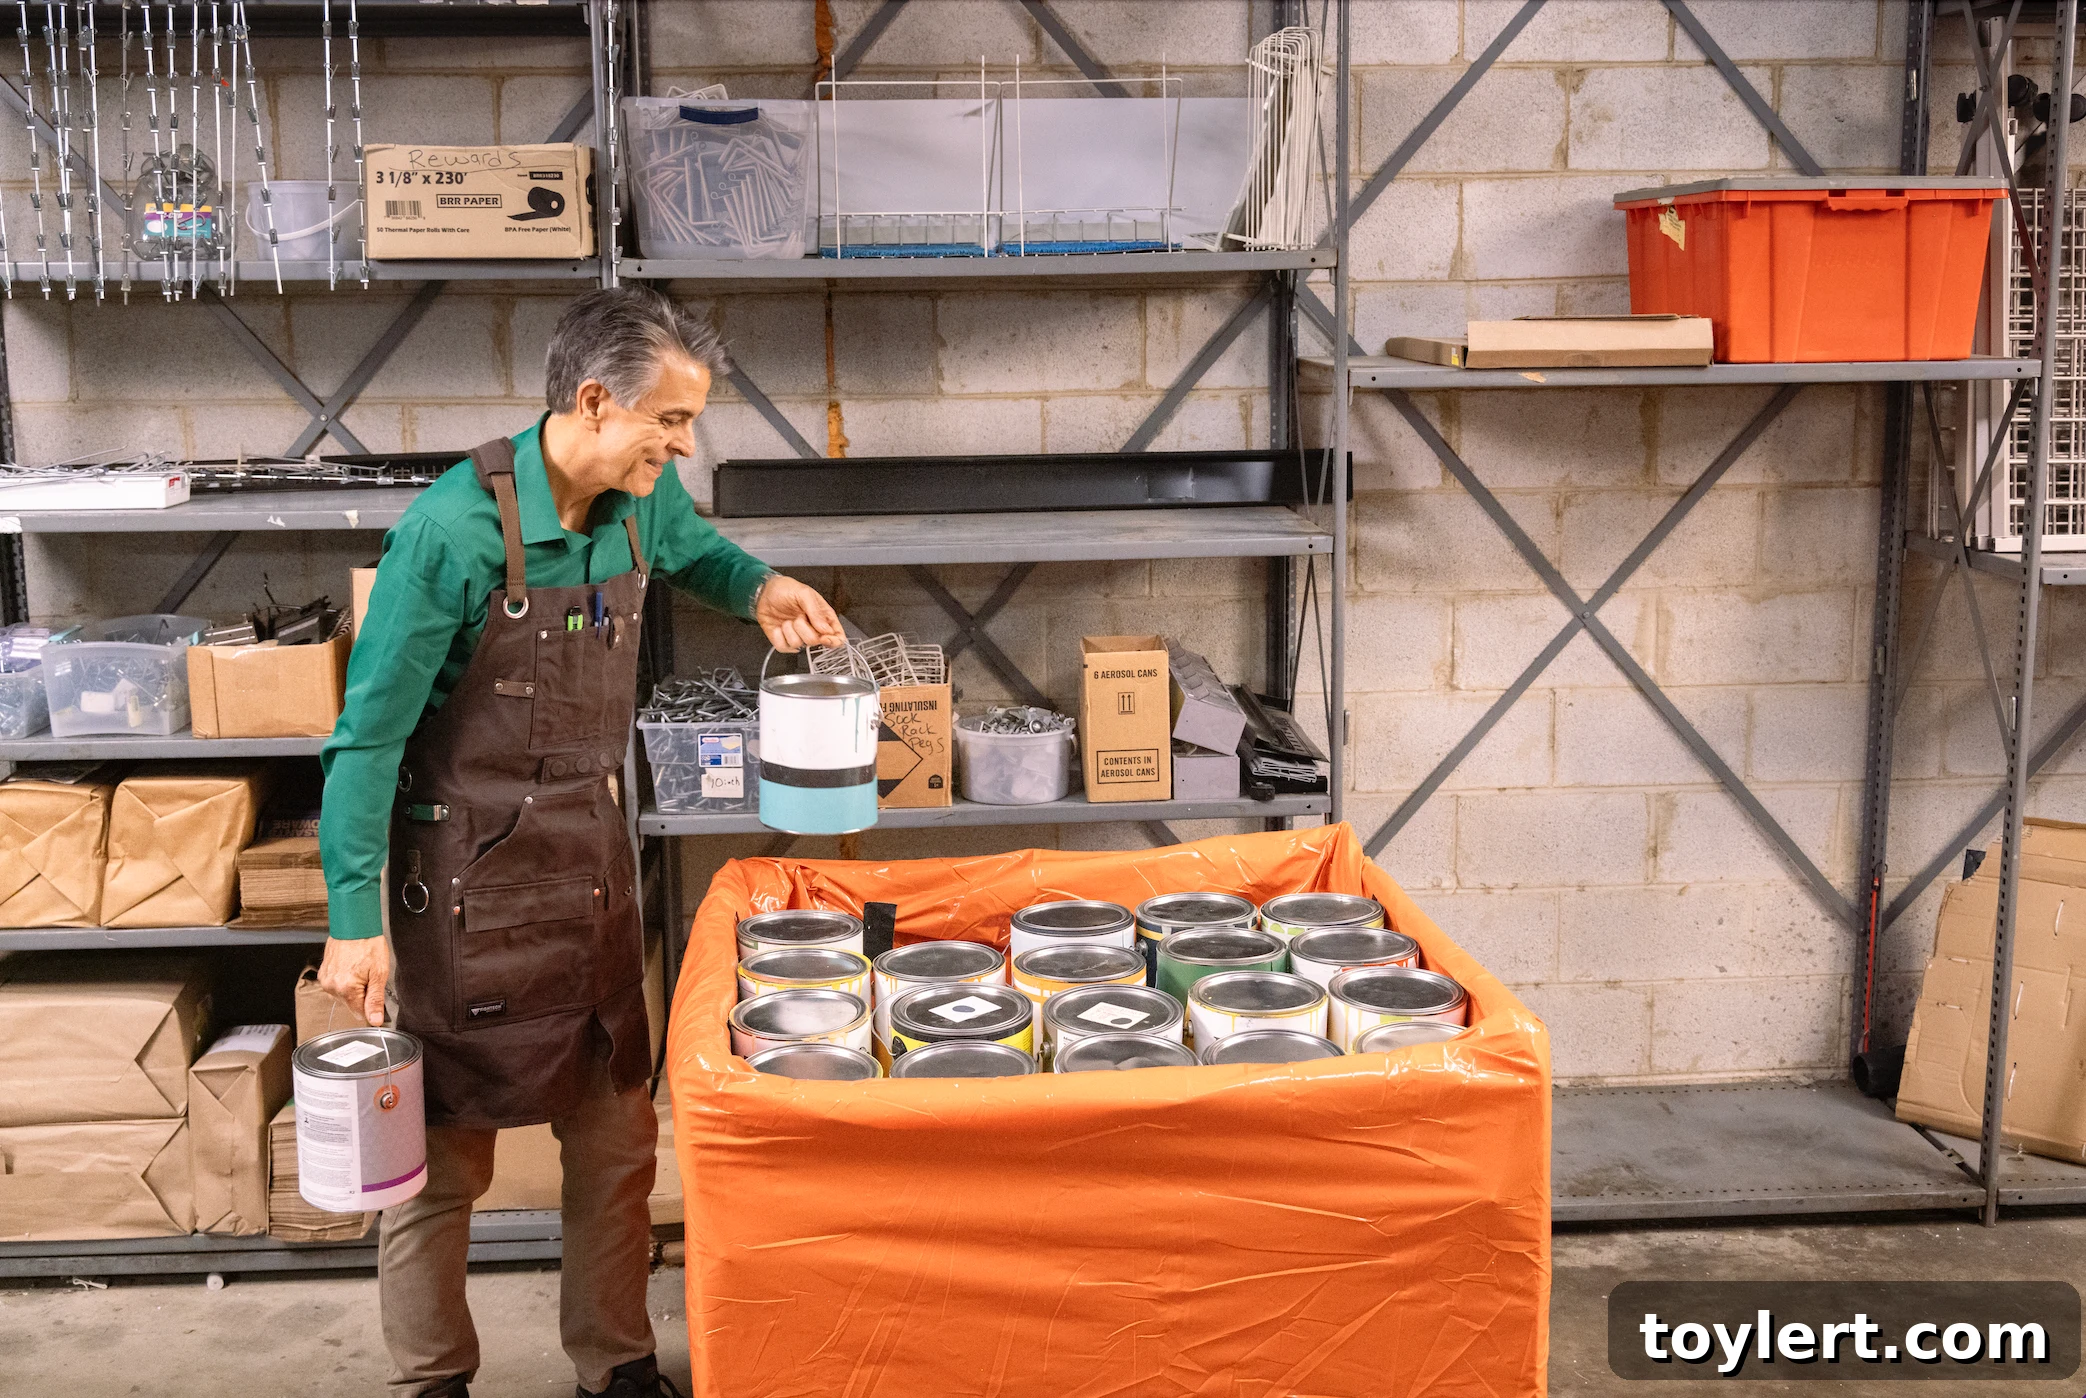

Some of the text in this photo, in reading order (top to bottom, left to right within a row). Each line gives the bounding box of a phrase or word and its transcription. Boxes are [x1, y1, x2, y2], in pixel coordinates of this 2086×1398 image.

[409, 149, 521, 169] Rewards
[376, 171, 384, 184] 3
[422, 174, 431, 185] x
[440, 197, 499, 205] BRR PAPER
[1093, 668, 1158, 679] 6 AEROSOL CANS
[889, 700, 938, 713] INSULATING
[901, 723, 938, 739] Rack
[1103, 755, 1152, 766] CONTENTS IN
[1100, 767, 1156, 778] AEROSOL CANS
